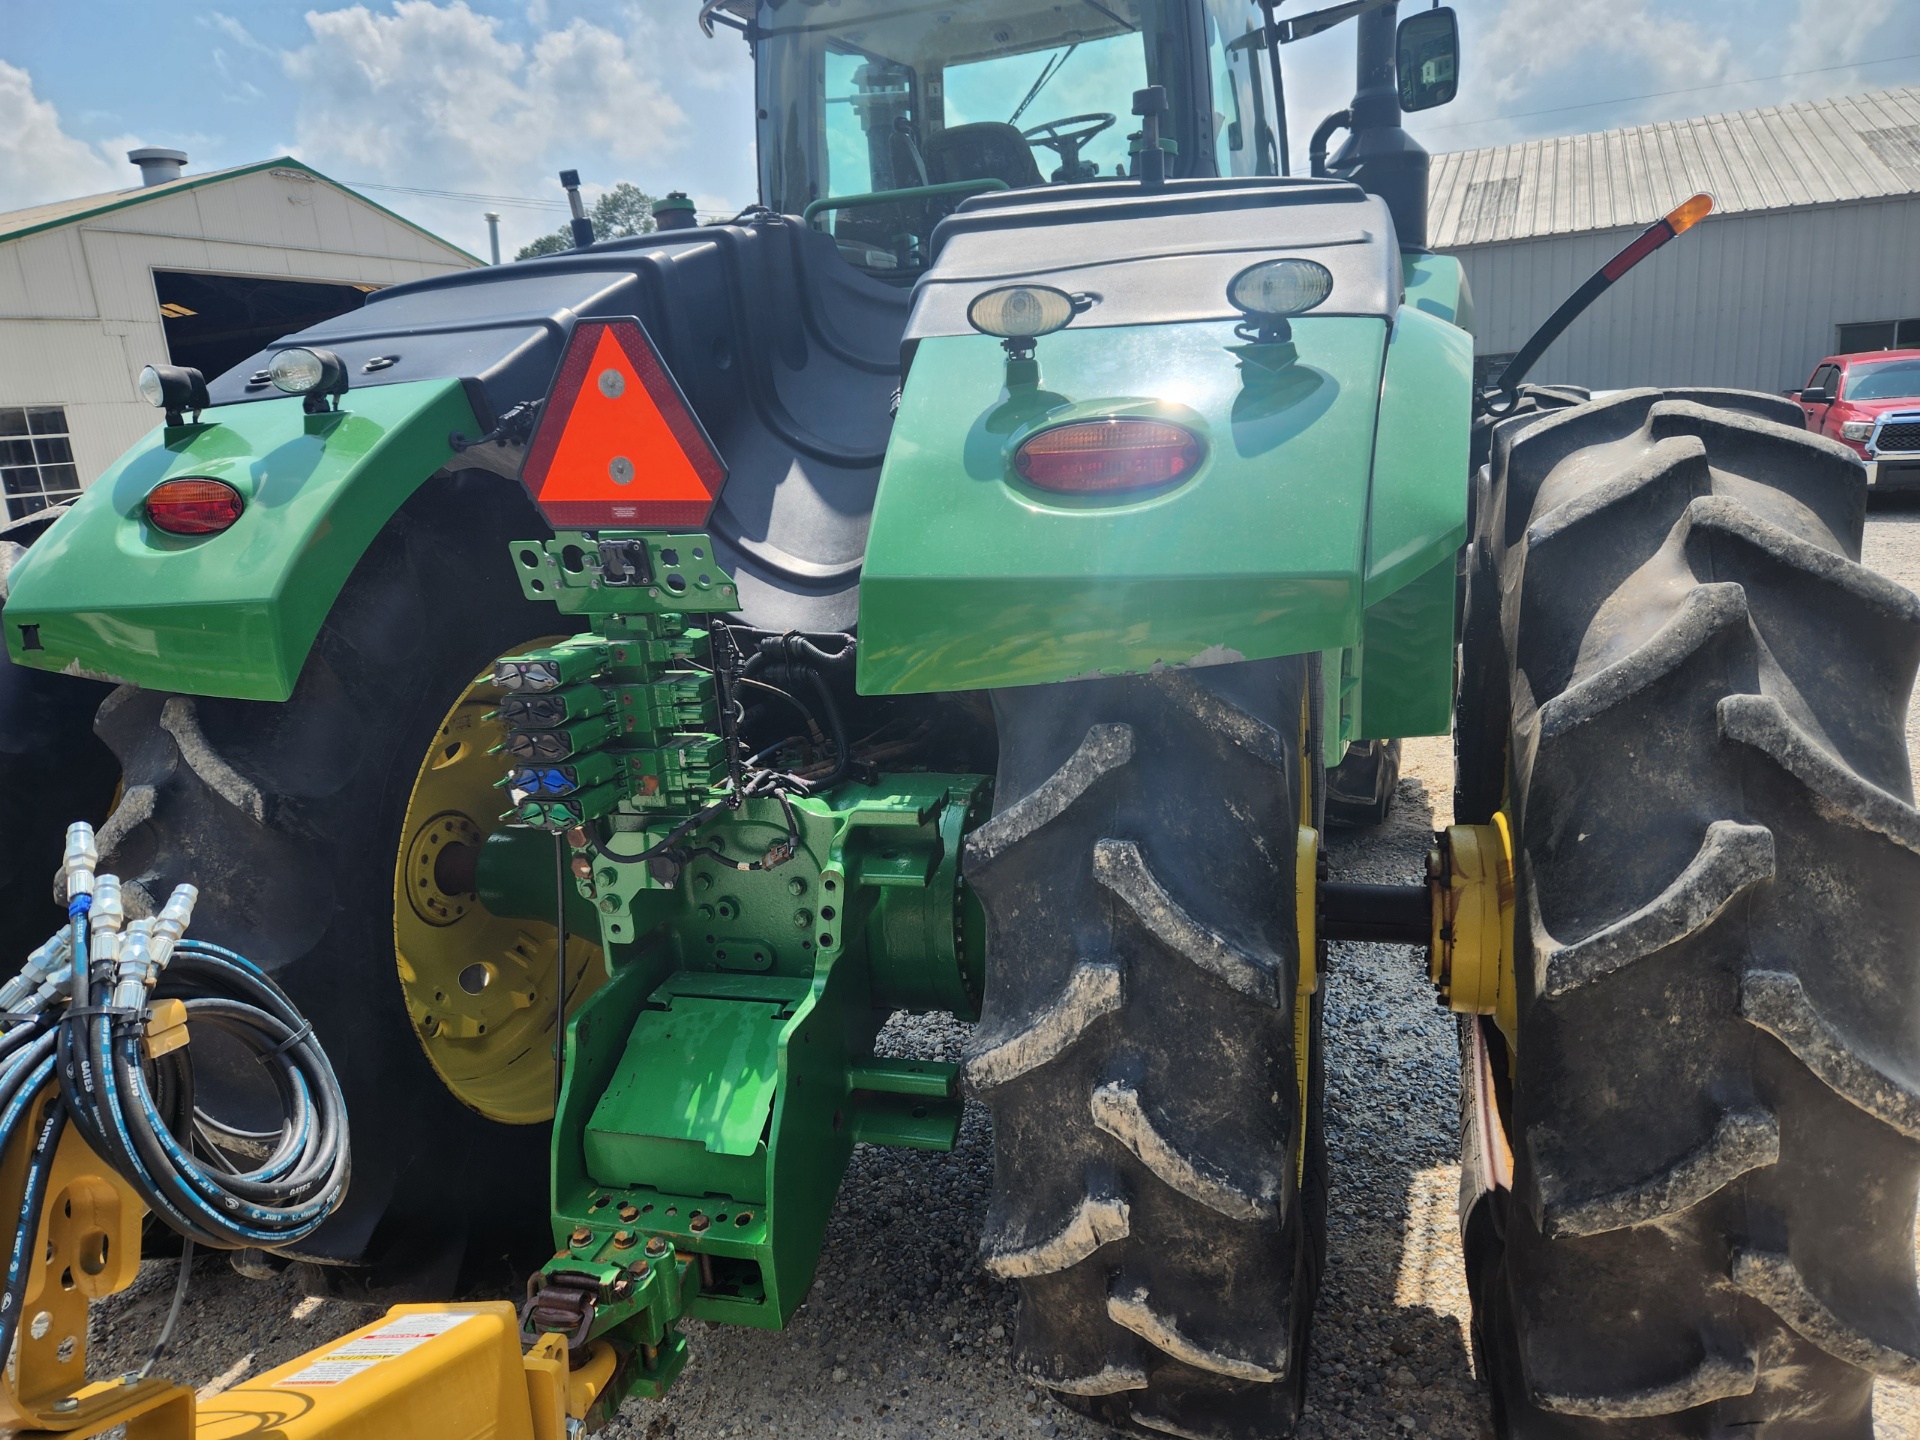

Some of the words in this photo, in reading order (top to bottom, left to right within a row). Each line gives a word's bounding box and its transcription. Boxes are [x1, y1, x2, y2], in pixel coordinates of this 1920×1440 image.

[102, 1034, 110, 1045] psi
[80, 1060, 95, 1093] GATES
[128, 1064, 140, 1097] GATES
[36, 1117, 55, 1152] GATES
[174, 1154, 188, 1166] psi
[183, 1164, 200, 1181] 4800
[289, 1182, 312, 1196] GATES
